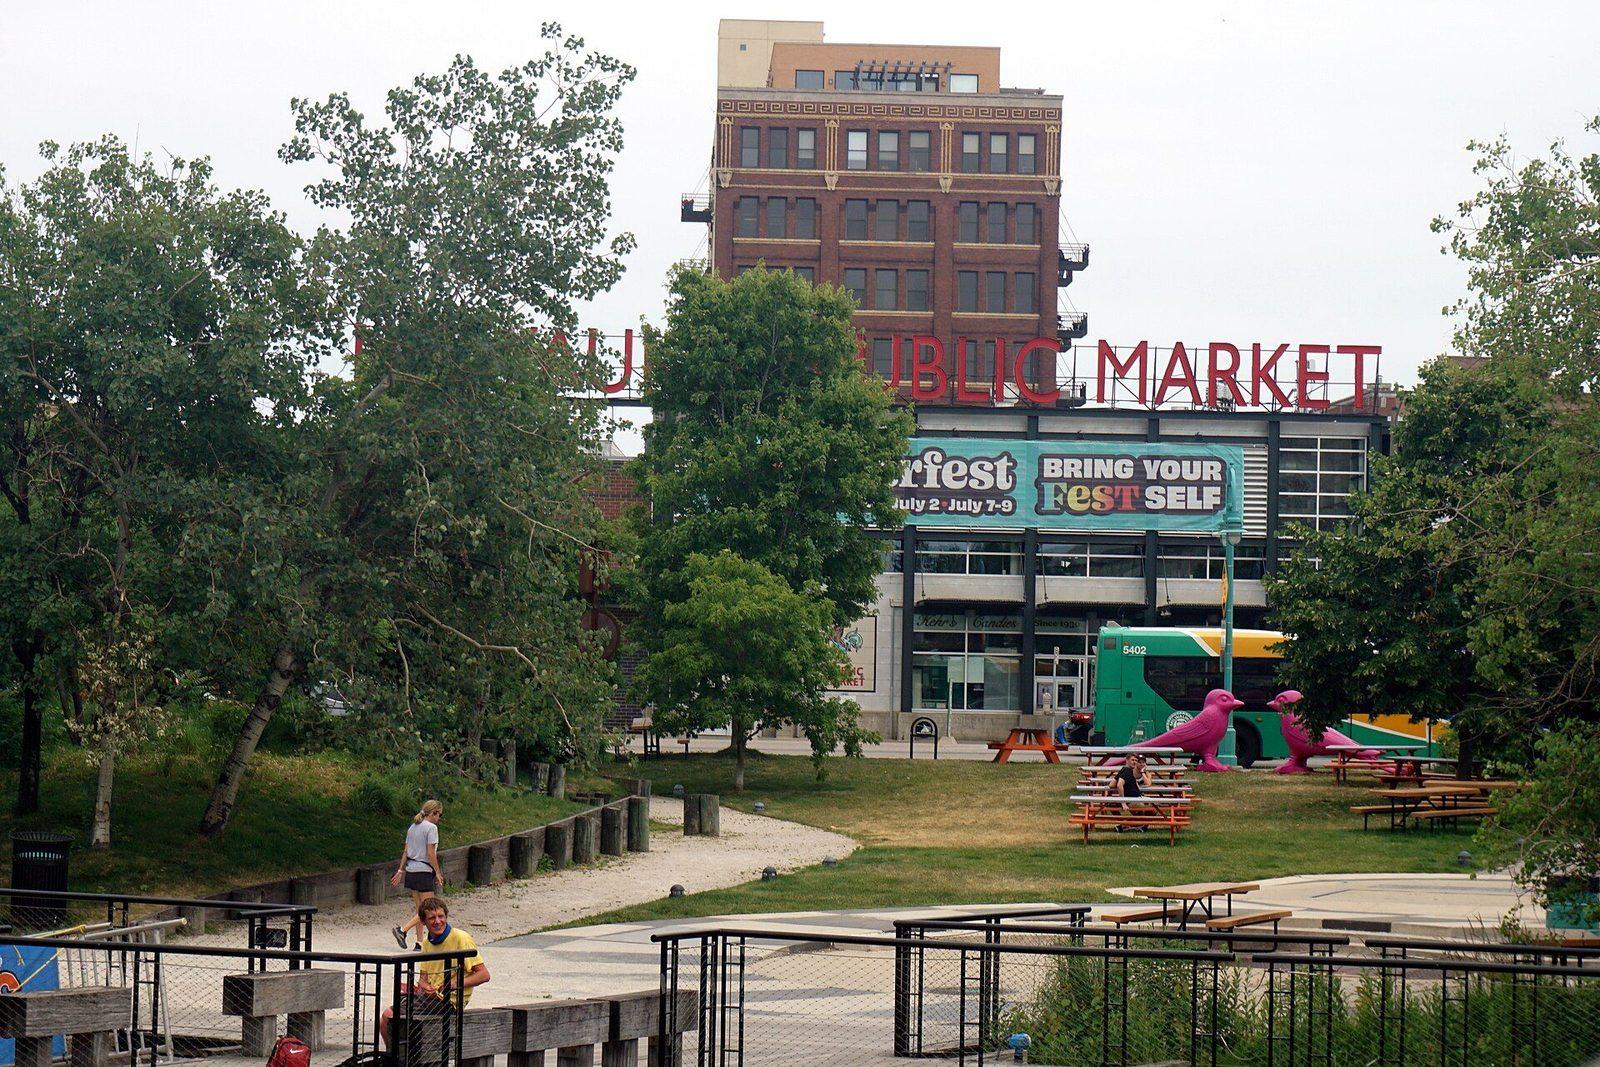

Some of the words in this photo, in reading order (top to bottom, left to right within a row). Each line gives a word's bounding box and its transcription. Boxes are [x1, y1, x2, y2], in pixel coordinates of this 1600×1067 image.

[856, 334, 1061, 404] UBLIC
[1096, 338, 1382, 410] MARKET
[1043, 457, 1134, 479] BRING
[1142, 459, 1223, 481] YOUR
[1144, 485, 1221, 510] SELF
[948, 498, 982, 514] July
[986, 499, 1013, 512] 7-9
[973, 614, 1017, 629] Candies
[1034, 618, 1057, 627] Since
[1122, 645, 1147, 655] 5402
